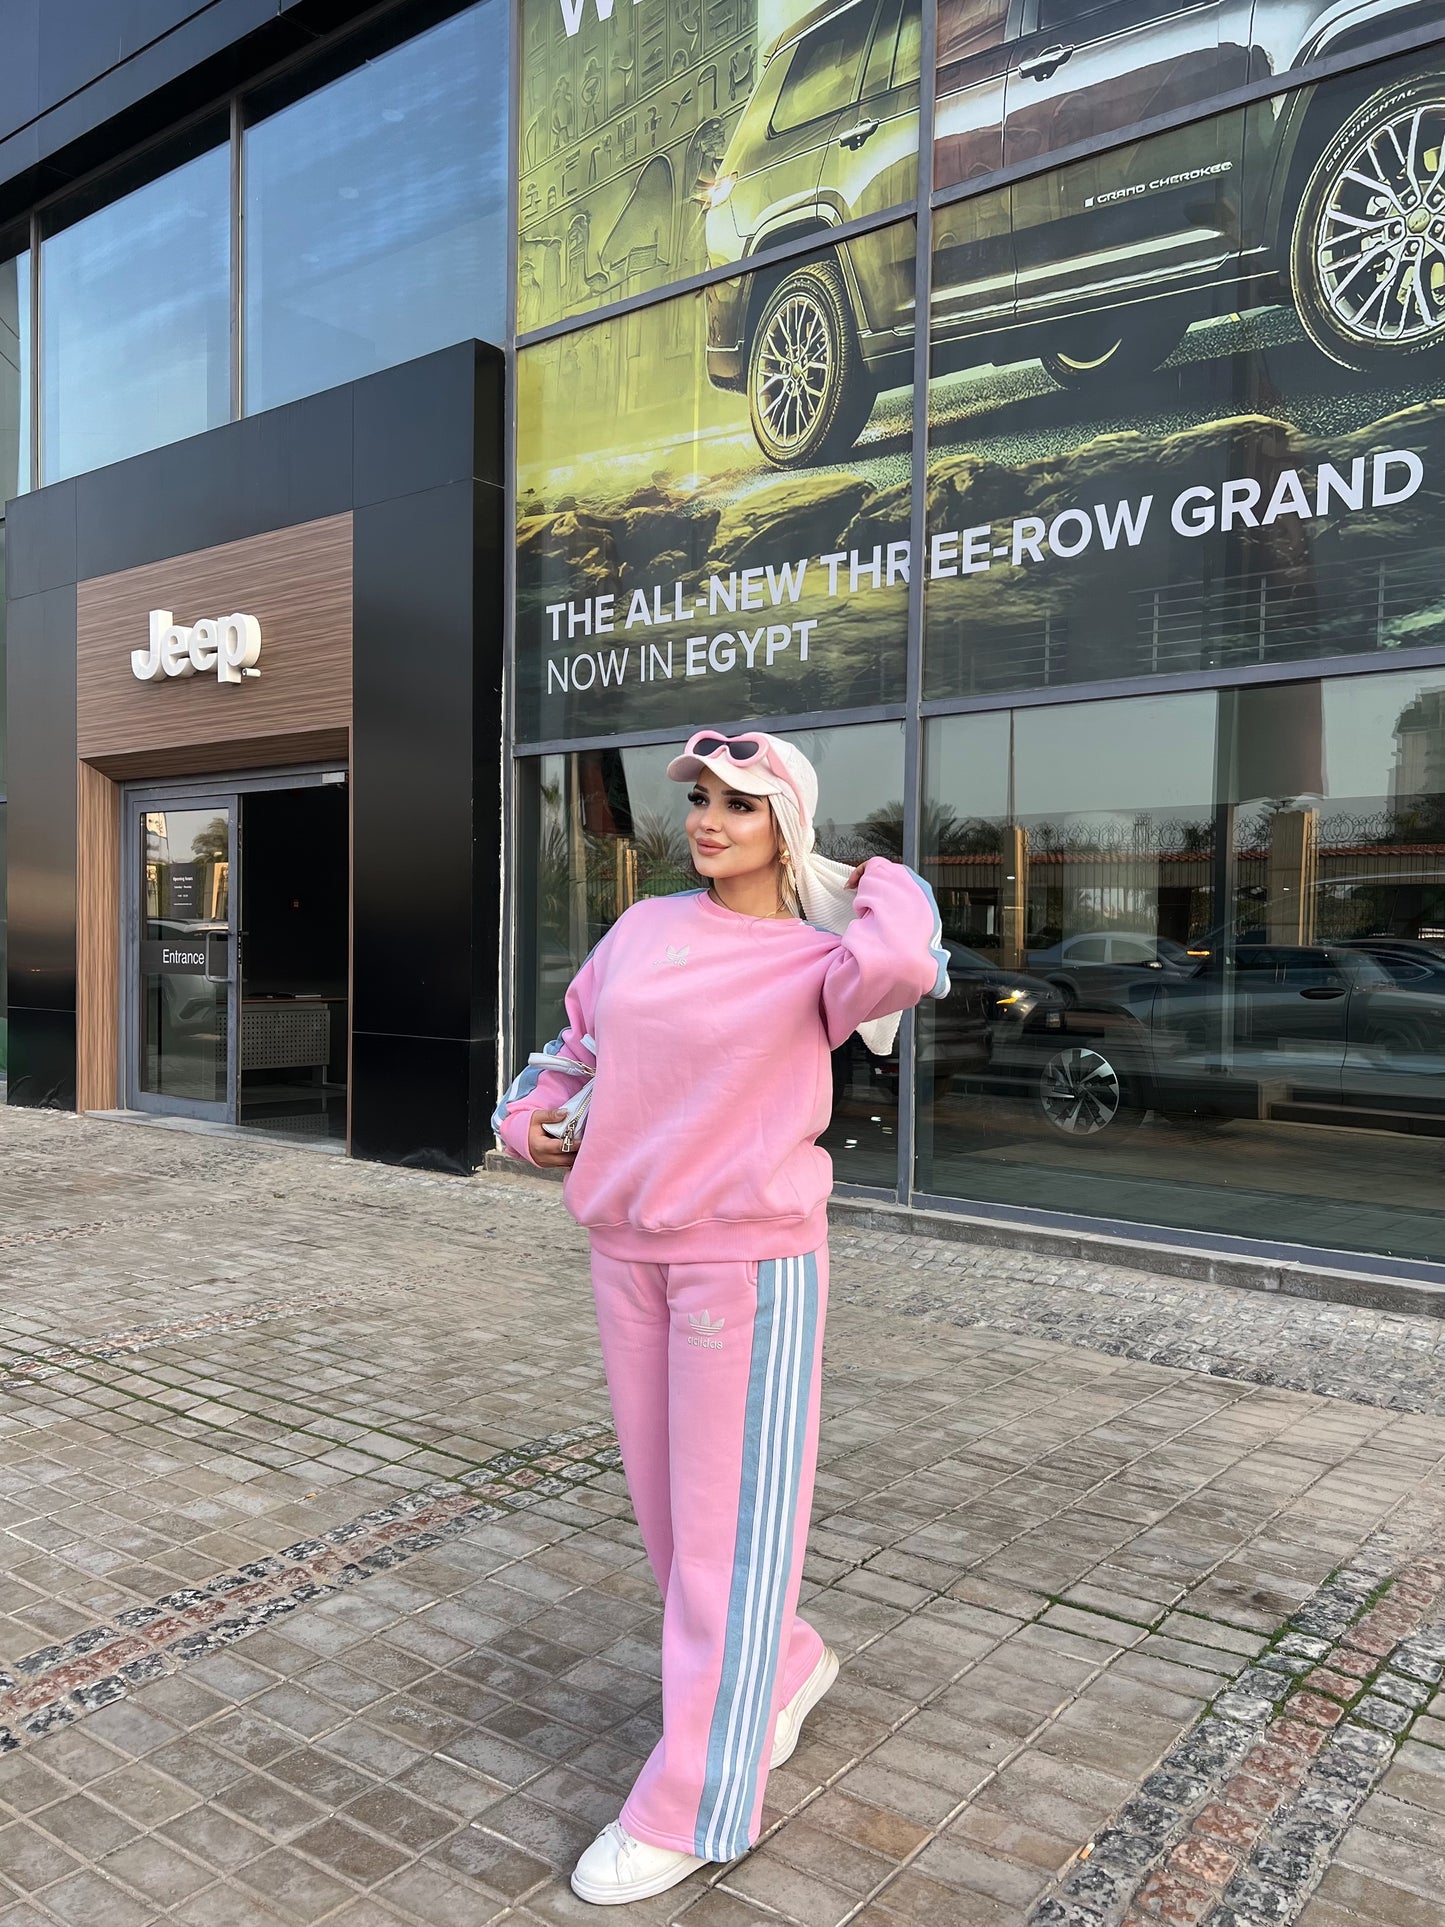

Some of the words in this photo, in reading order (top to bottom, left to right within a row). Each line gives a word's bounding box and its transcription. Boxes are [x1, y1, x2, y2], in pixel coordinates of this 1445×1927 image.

[1097, 184, 1146, 204] GRAND
[1148, 161, 1233, 190] CHEROKEE
[546, 593, 615, 641] THE
[624, 558, 808, 630] ALL-NEW
[820, 495, 1154, 597] THREE-ROW
[1170, 449, 1425, 538] GRAND
[130, 608, 262, 684] Jeep
[547, 647, 630, 695] NOW
[640, 641, 673, 683] IN
[686, 619, 818, 677] EGYPT
[162, 948, 205, 965] Entrance
[687, 1336, 724, 1350] adidas
